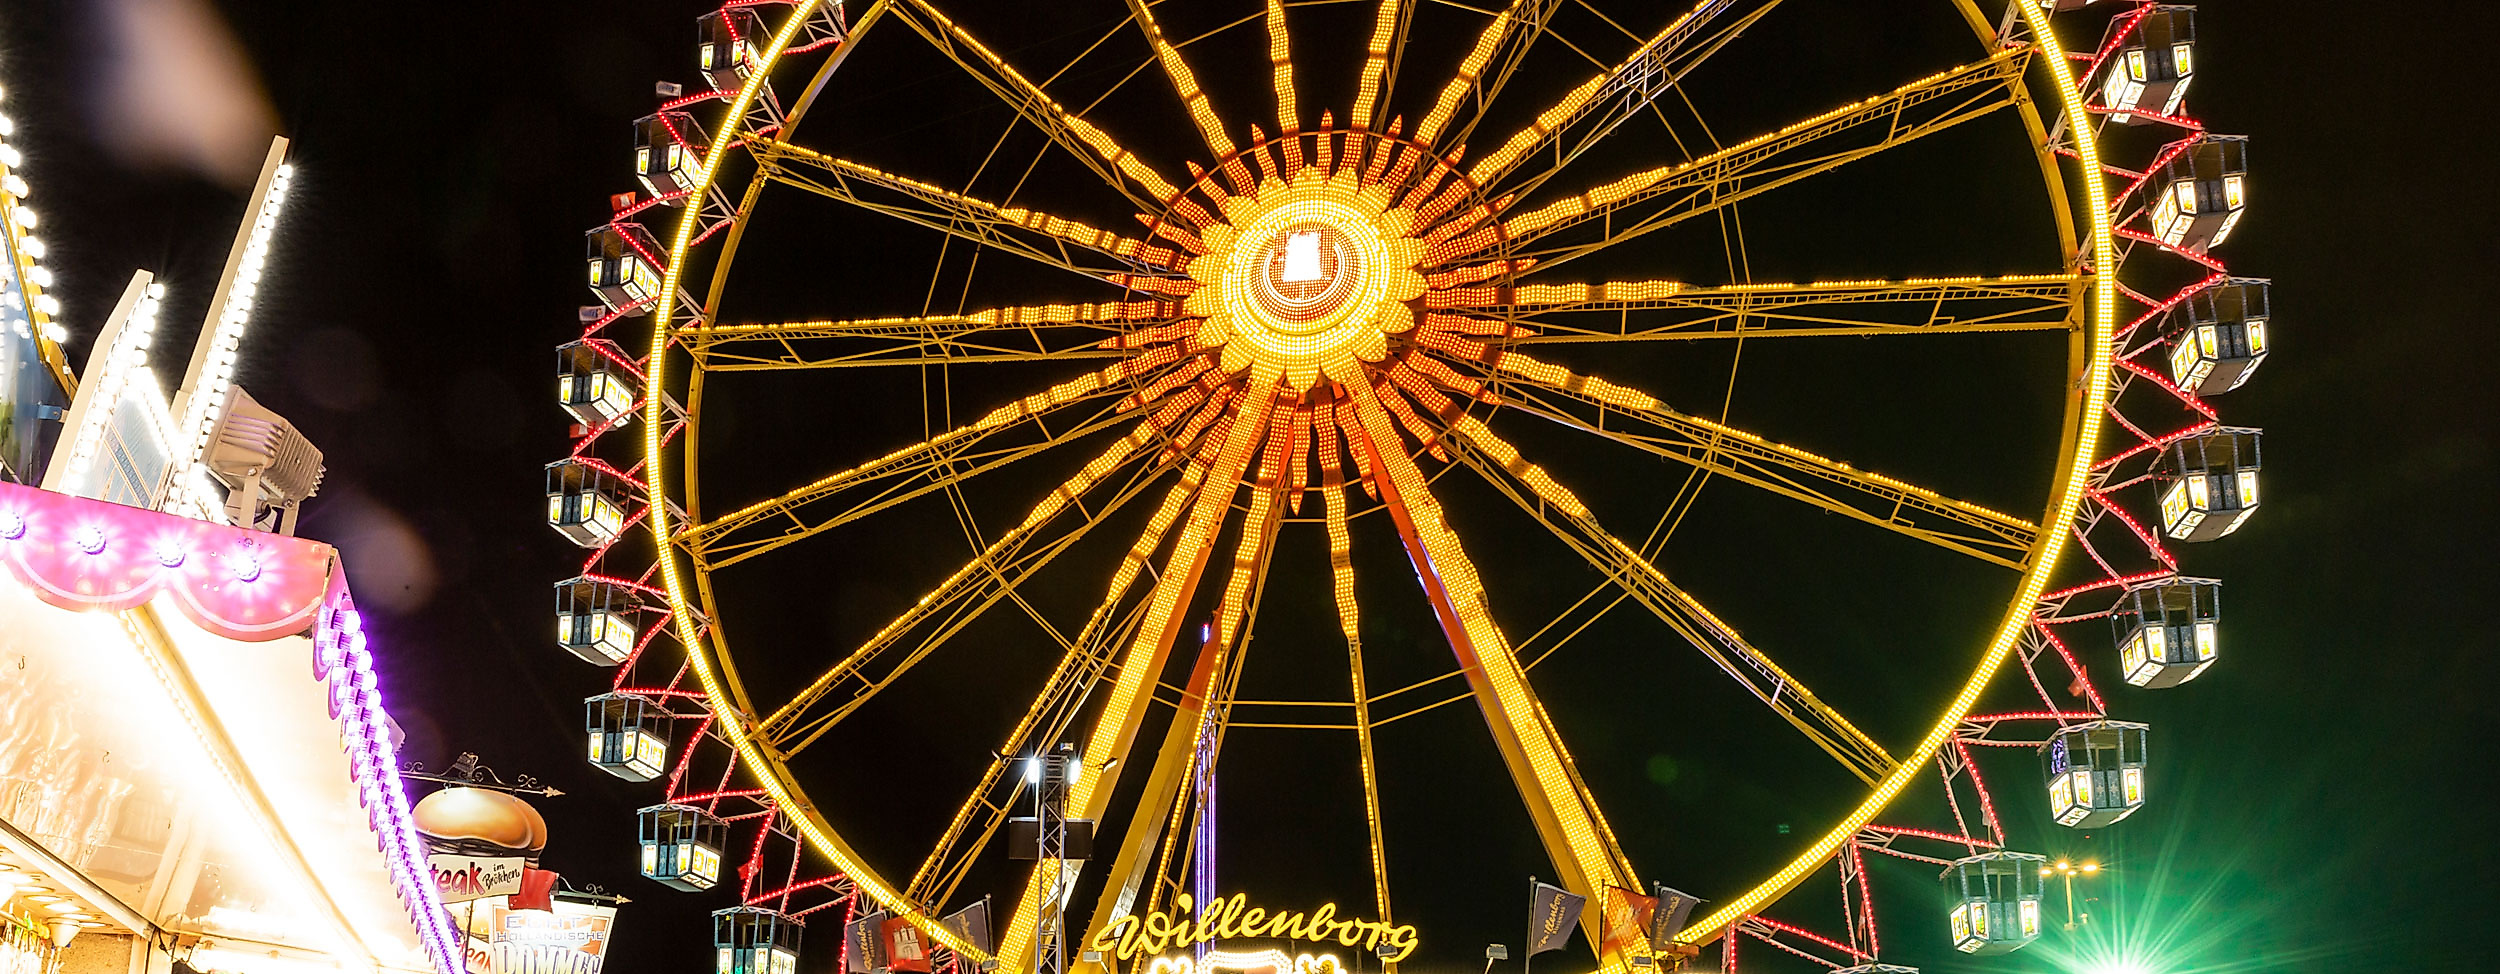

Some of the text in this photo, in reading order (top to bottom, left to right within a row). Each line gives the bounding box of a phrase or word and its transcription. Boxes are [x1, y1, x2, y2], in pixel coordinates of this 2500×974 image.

[429, 861, 505, 896] teak im
[1091, 892, 1419, 963] Willenborg
